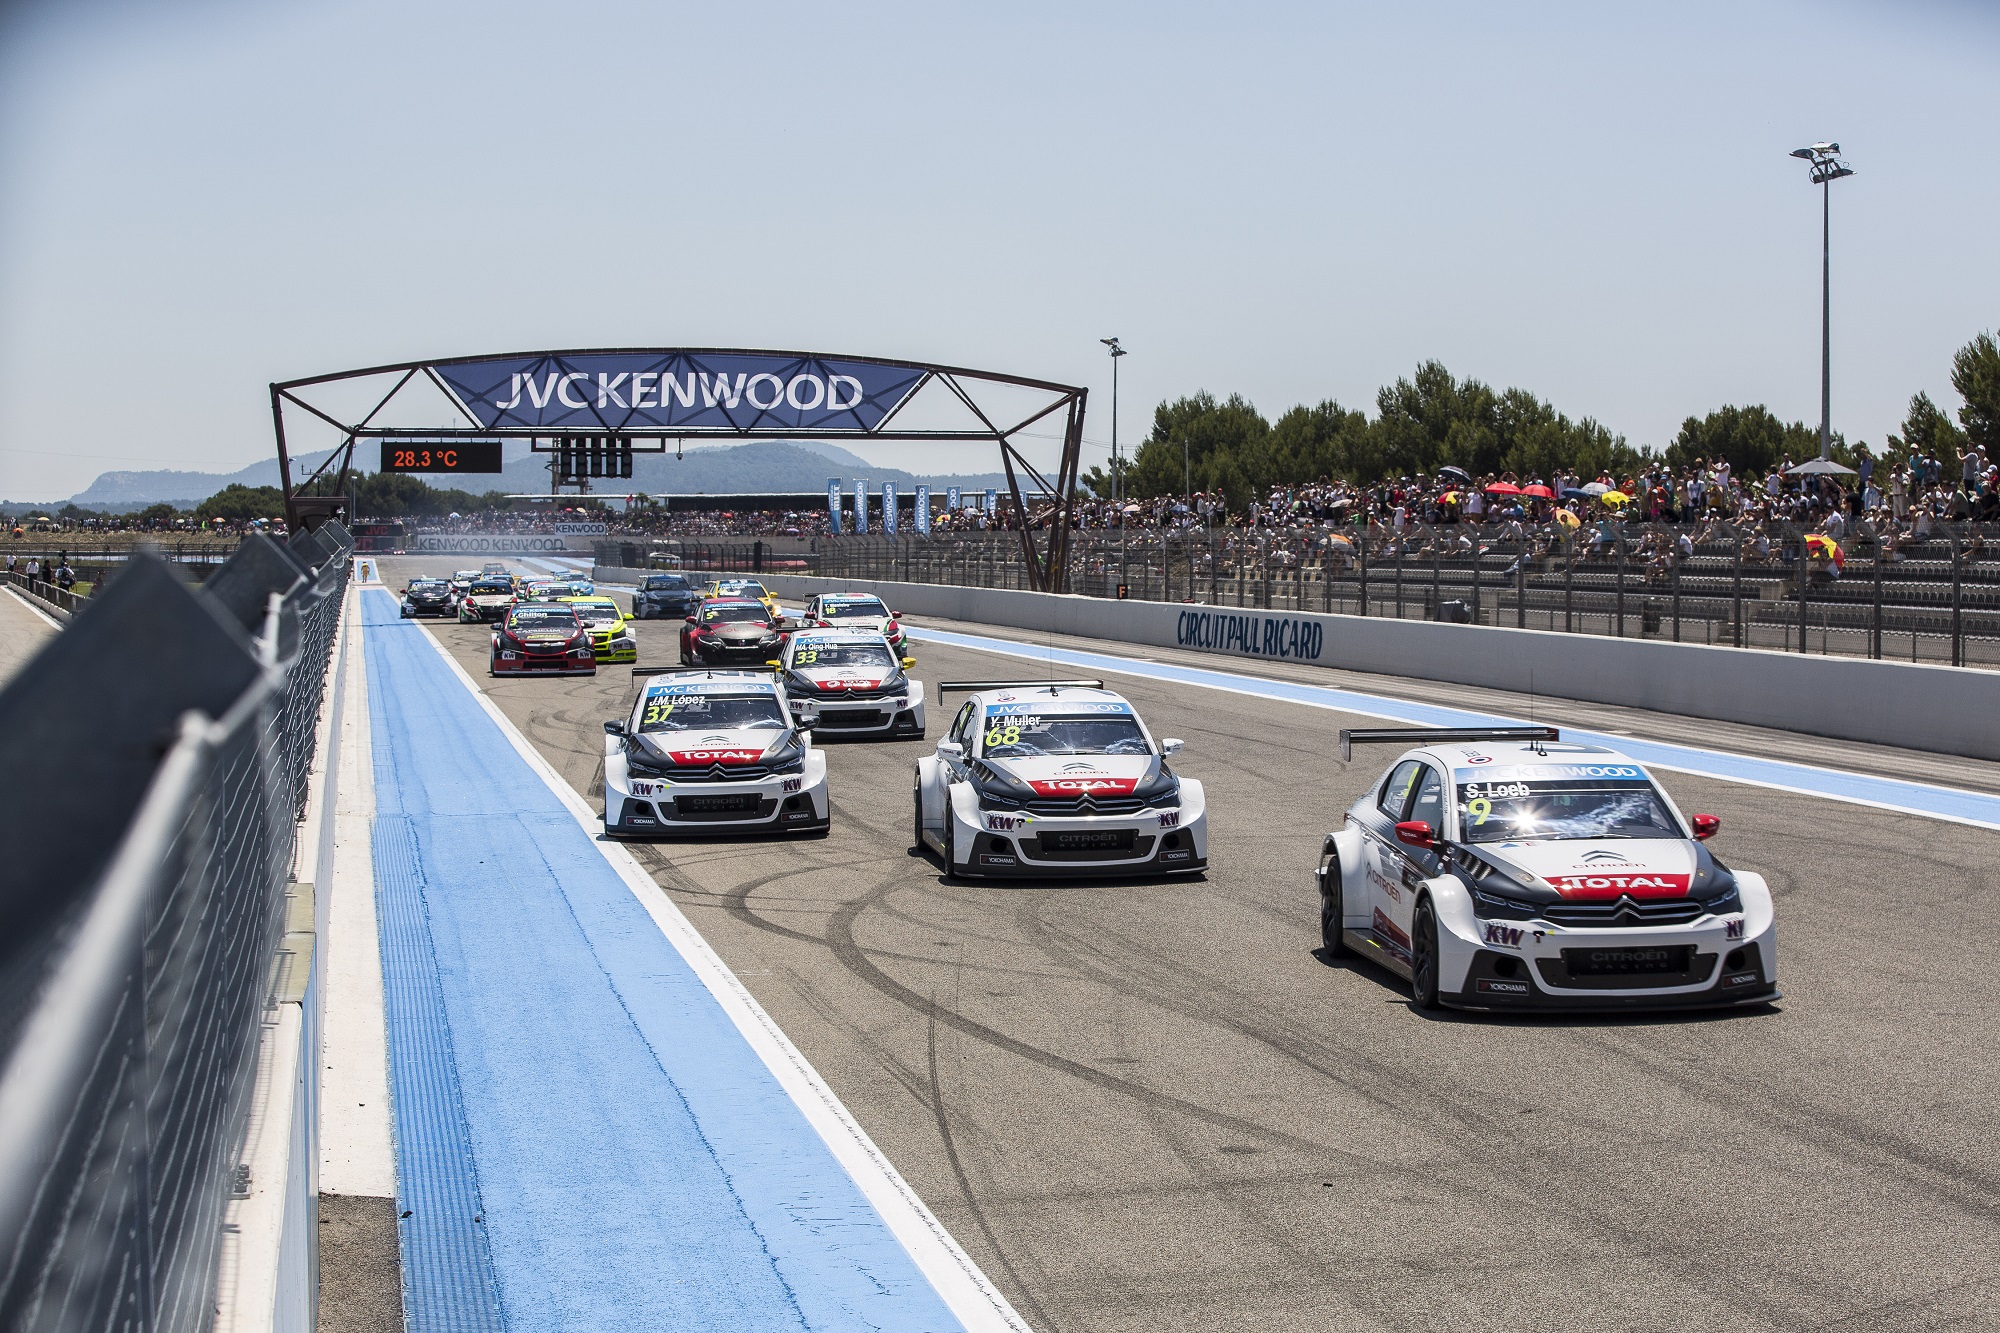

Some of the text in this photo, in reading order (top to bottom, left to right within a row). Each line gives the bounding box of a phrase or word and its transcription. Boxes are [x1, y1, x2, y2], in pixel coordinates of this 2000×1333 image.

[394, 450, 458, 467] 28.3 °C
[365, 525, 388, 536] JVC
[555, 524, 605, 534] KENWOOD
[419, 538, 564, 551] KENWOOD KENWOOD
[1119, 586, 1126, 598] F
[705, 612, 714, 620] 5
[825, 607, 836, 615] 18
[509, 617, 518, 626] 3
[1177, 610, 1323, 660] CIRCUIT PAUL RICARD
[808, 643, 824, 652] Qing
[825, 642, 838, 650] Hua
[795, 651, 817, 665] 33
[649, 694, 706, 707] J.M. López
[644, 704, 675, 724] 37
[991, 715, 1041, 728] Y. Muller
[985, 726, 1020, 747] 68
[679, 751, 751, 760] TOTAL
[632, 783, 653, 796] KW
[783, 779, 801, 792] KW
[1041, 780, 1126, 790] TOTAL
[1466, 783, 1484, 799] S.
[1486, 781, 1531, 797] Loeb
[1468, 798, 1492, 826] 9
[988, 815, 1016, 830] KW
[1160, 812, 1180, 827] KW
[1561, 876, 1677, 889] TOTAL
[1485, 923, 1525, 946] KW
[1489, 982, 1527, 993] YOKOHAMA
